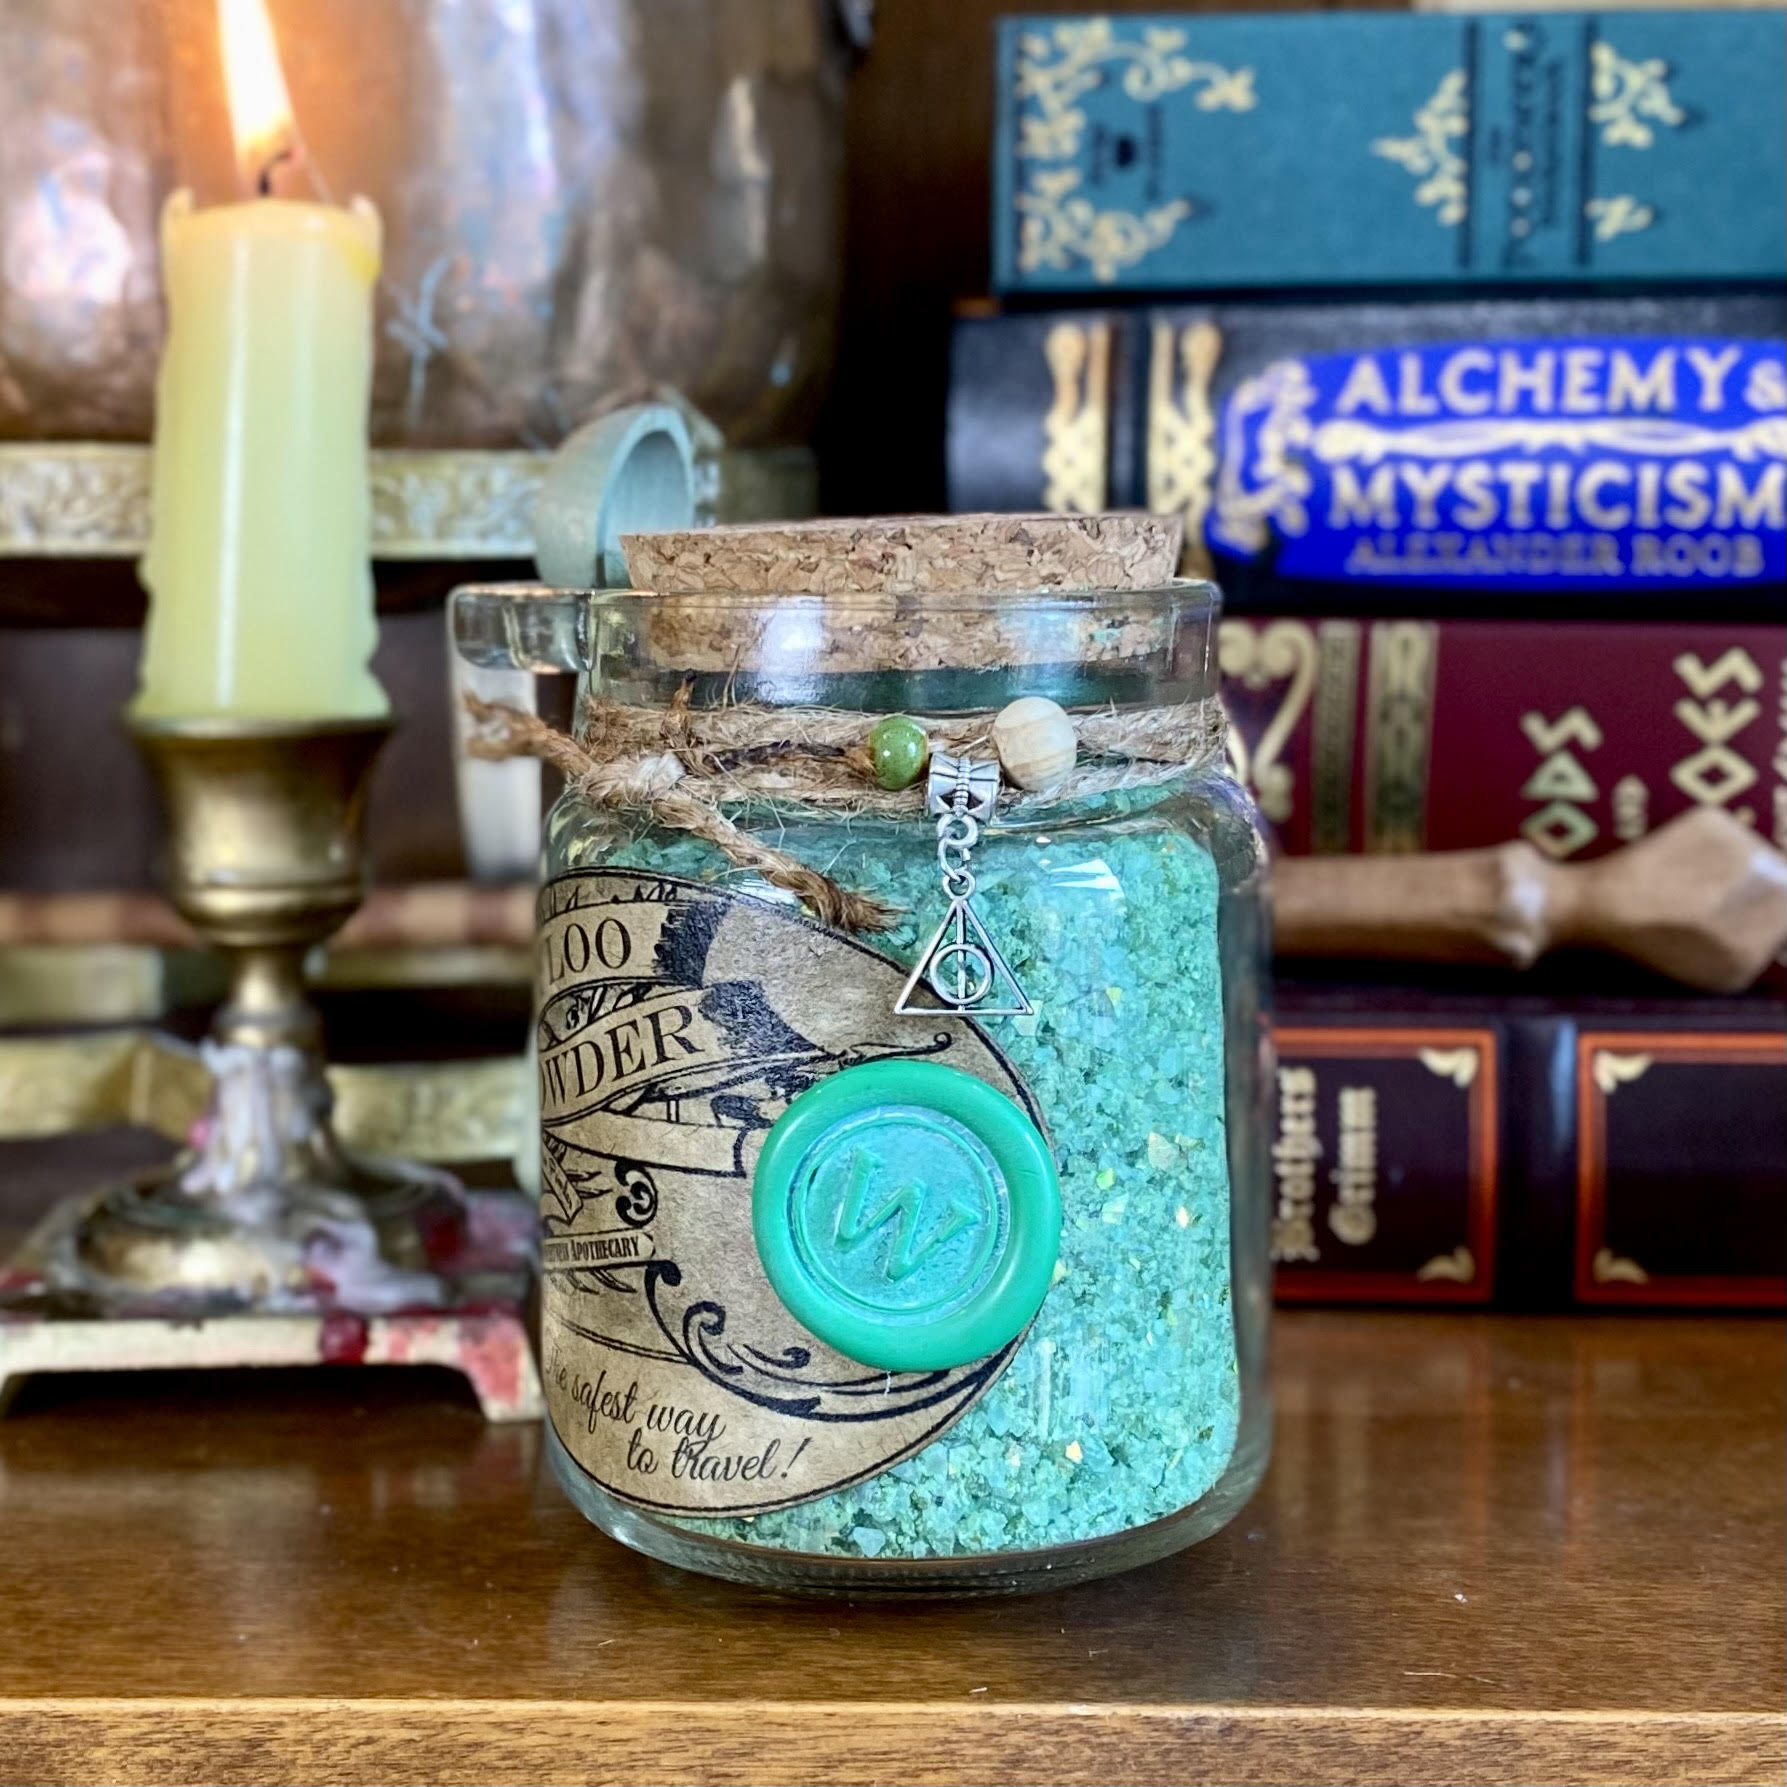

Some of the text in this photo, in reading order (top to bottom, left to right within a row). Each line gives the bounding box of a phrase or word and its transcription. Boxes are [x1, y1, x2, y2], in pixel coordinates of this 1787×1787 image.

[1335, 346, 1742, 415] ALCHEMY
[1327, 461, 1787, 531] MYSTICISM
[1344, 532, 1765, 578] ALEXANDER ROOB
[1520, 705, 1603, 860] ODS
[545, 918, 632, 985] LOO
[540, 1004, 706, 1108] WDER
[1328, 1086, 1377, 1245] Grimm
[571, 1369, 638, 1435] safest
[646, 1402, 726, 1447] way
[627, 1427, 659, 1474] to
